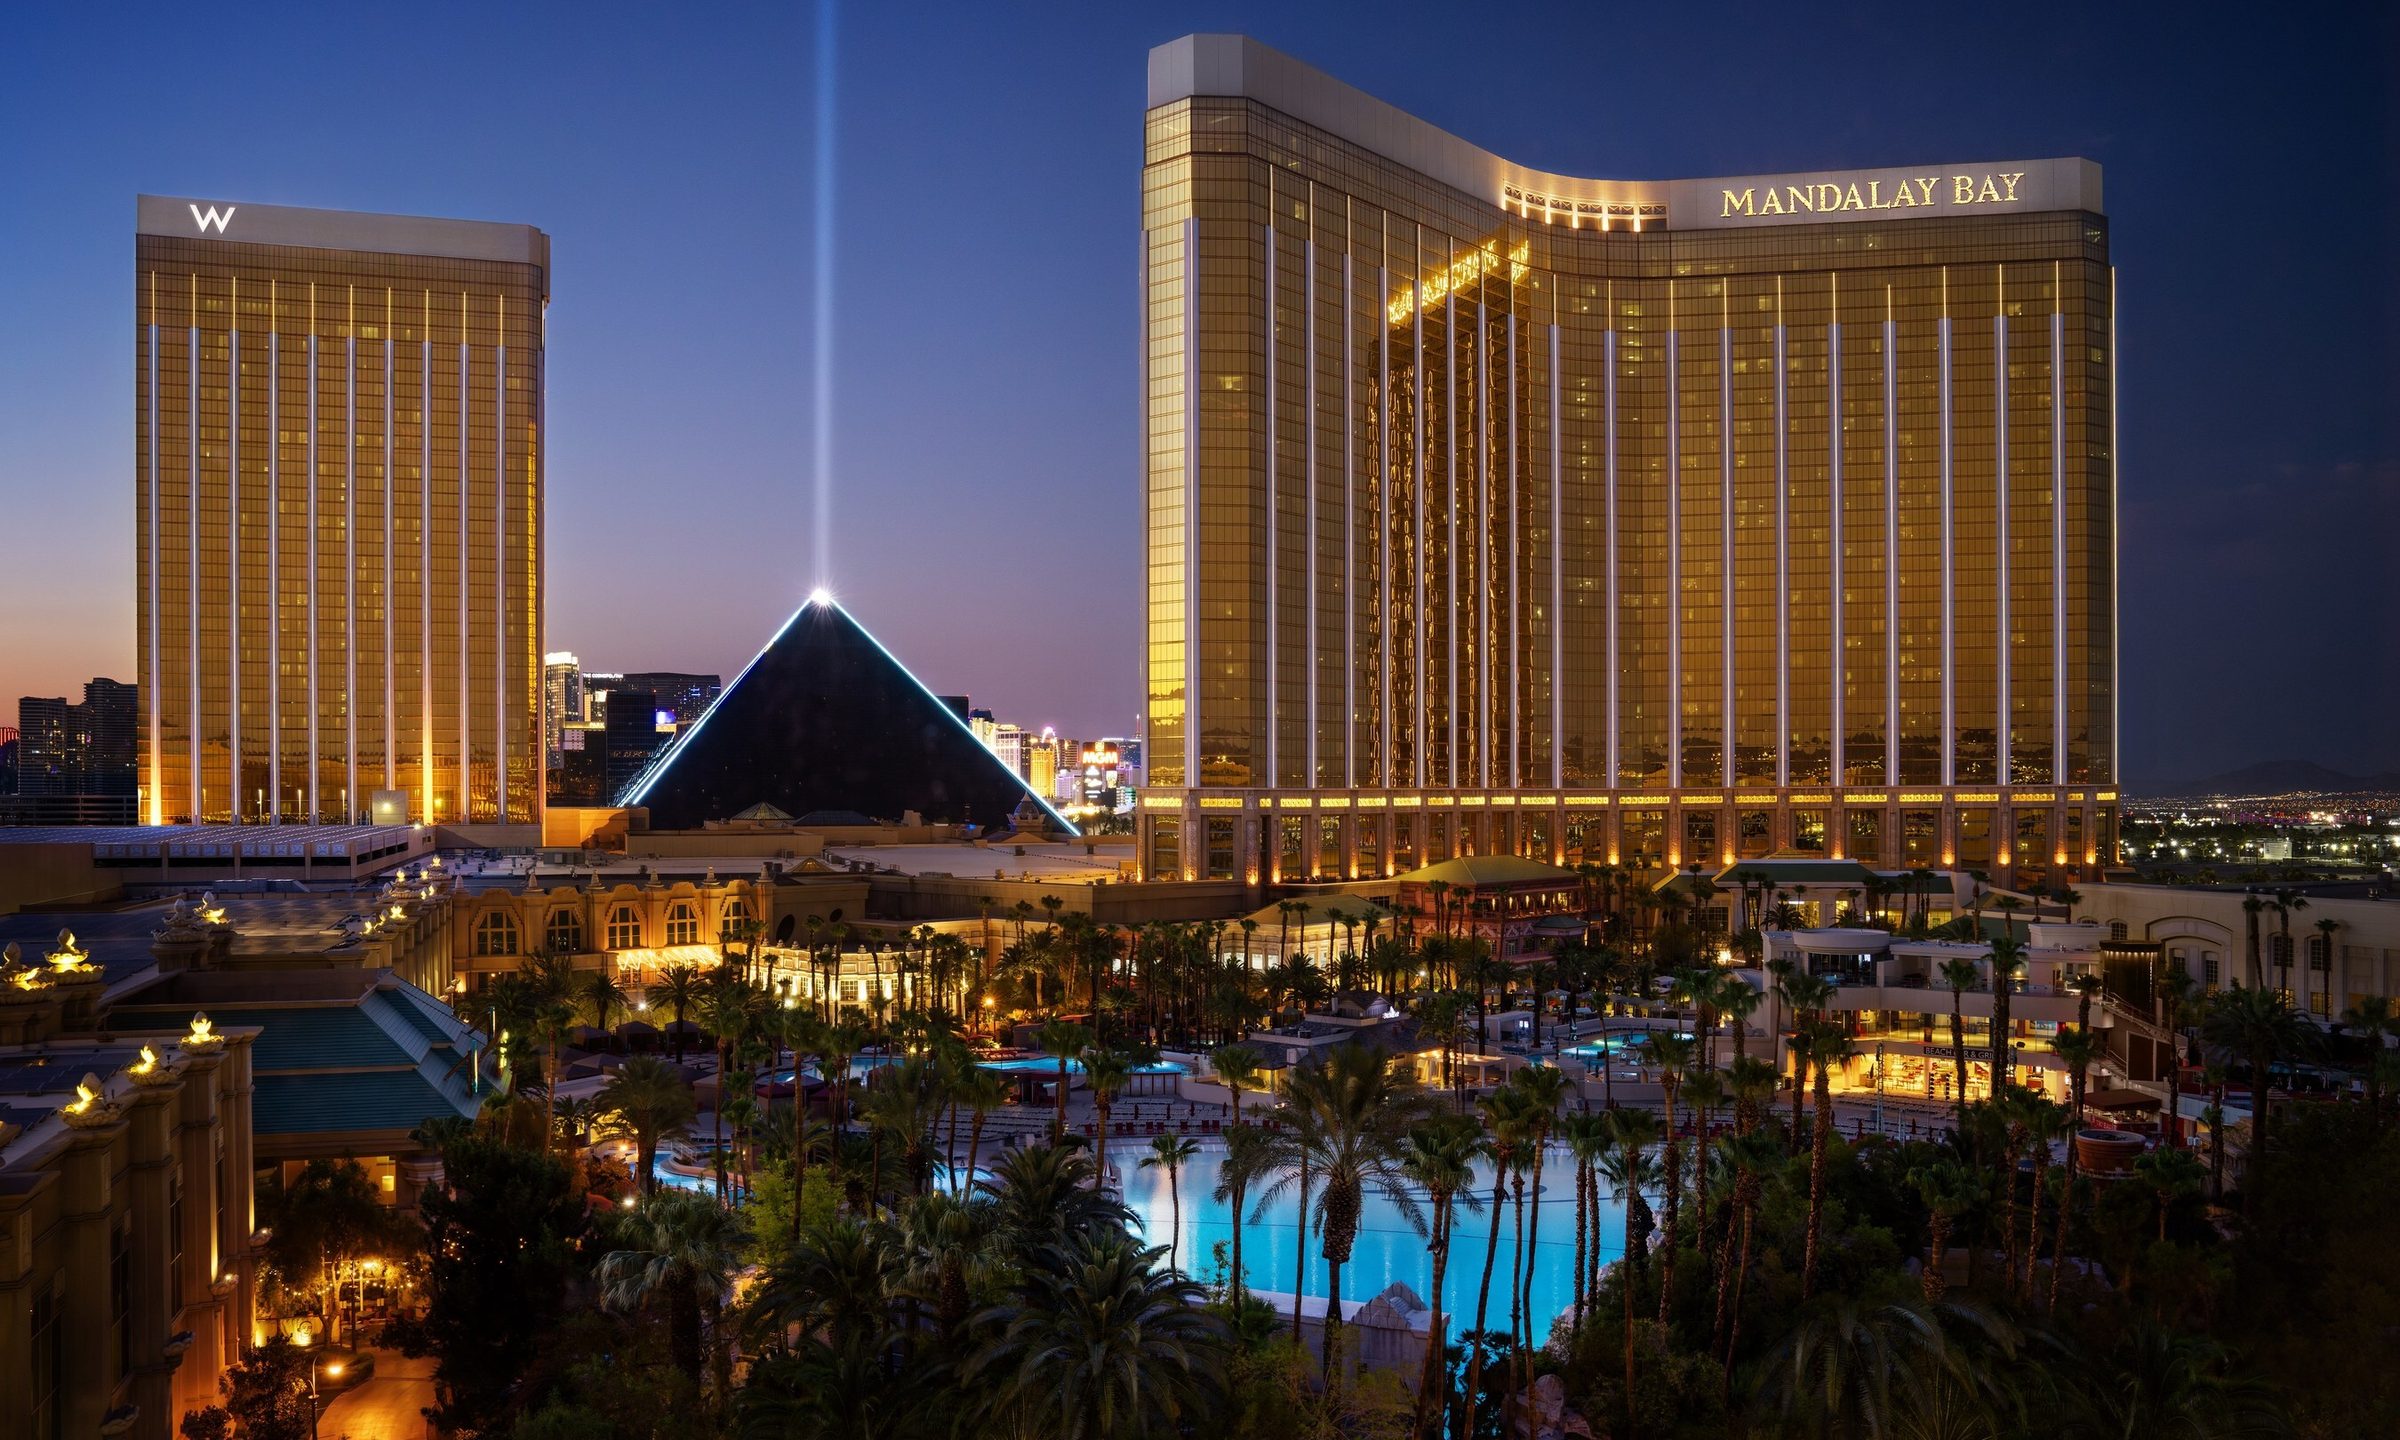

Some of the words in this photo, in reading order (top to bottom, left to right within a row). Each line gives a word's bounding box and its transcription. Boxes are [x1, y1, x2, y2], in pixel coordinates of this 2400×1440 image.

[1720, 177, 1941, 217] MANDALAY
[1952, 172, 2025, 204] BAY
[189, 204, 236, 234] W
[1083, 752, 1118, 764] MGM
[1925, 1047, 1952, 1056] BEACH
